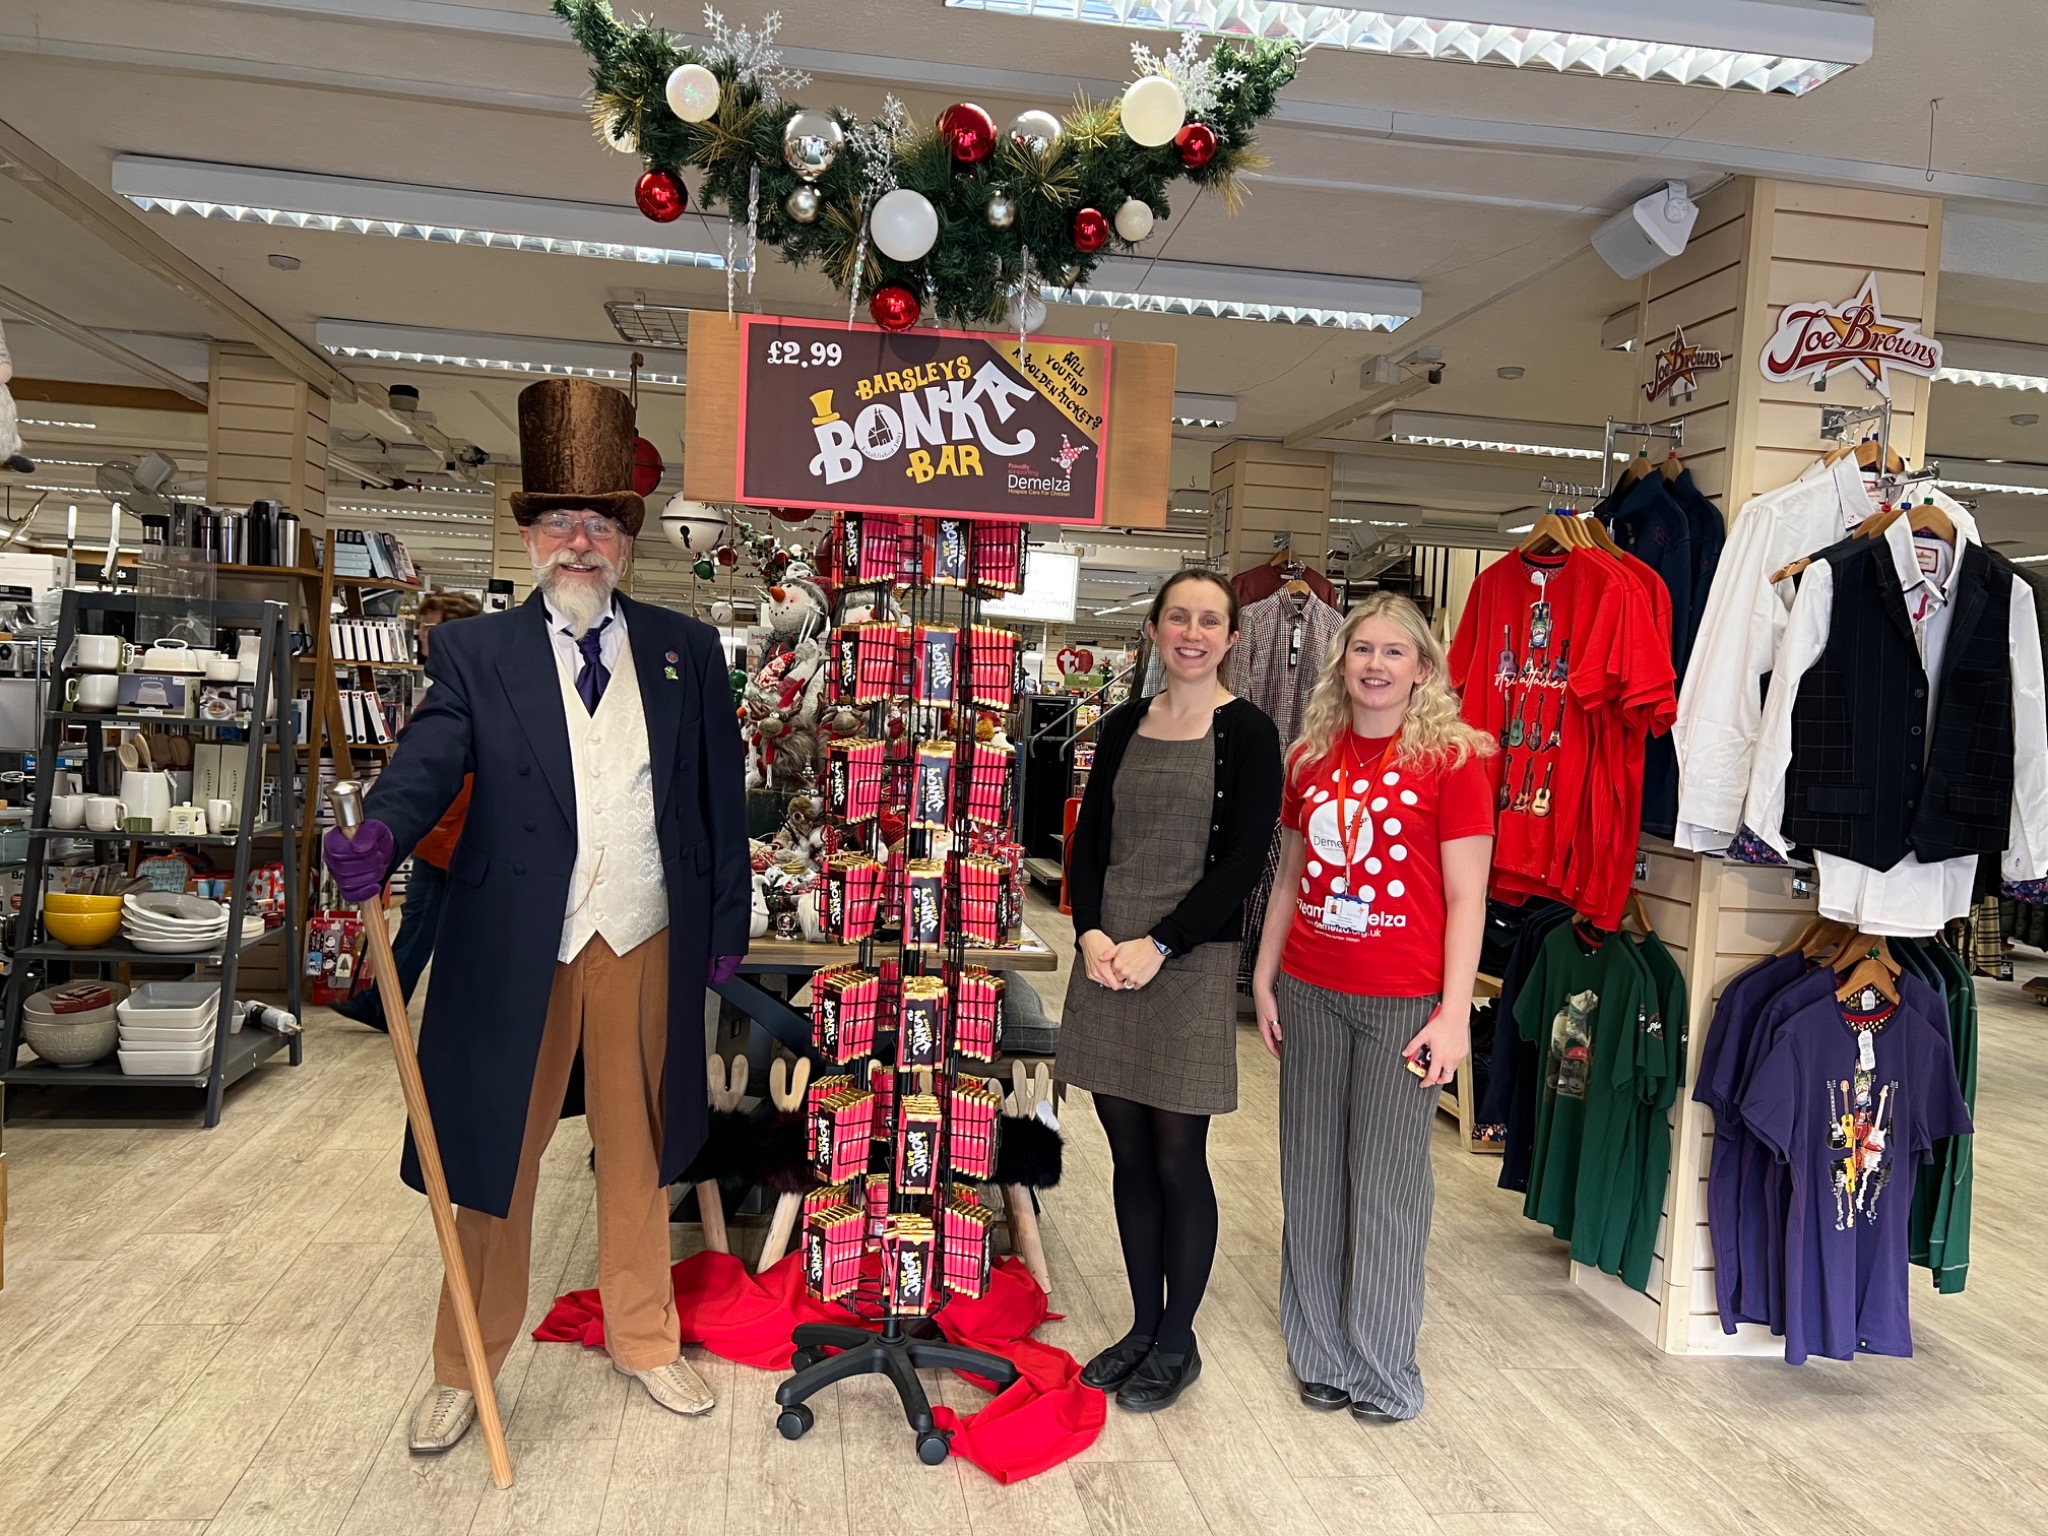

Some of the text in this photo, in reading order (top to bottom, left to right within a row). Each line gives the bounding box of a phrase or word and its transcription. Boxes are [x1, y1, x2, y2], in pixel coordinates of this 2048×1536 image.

[767, 340, 843, 368] £2.99
[1767, 305, 1938, 374] Joe Browns
[855, 356, 972, 401] BARSLEYS
[1012, 347, 1103, 430] A GOLDEN TICKET?
[1045, 354, 1088, 396] YOU FIND
[1646, 340, 1722, 400] Joe Browns
[809, 360, 1036, 485] BONKA
[906, 444, 984, 485] BAR
[1008, 474, 1071, 492] Demelza
[1313, 835, 1343, 848] Deme
